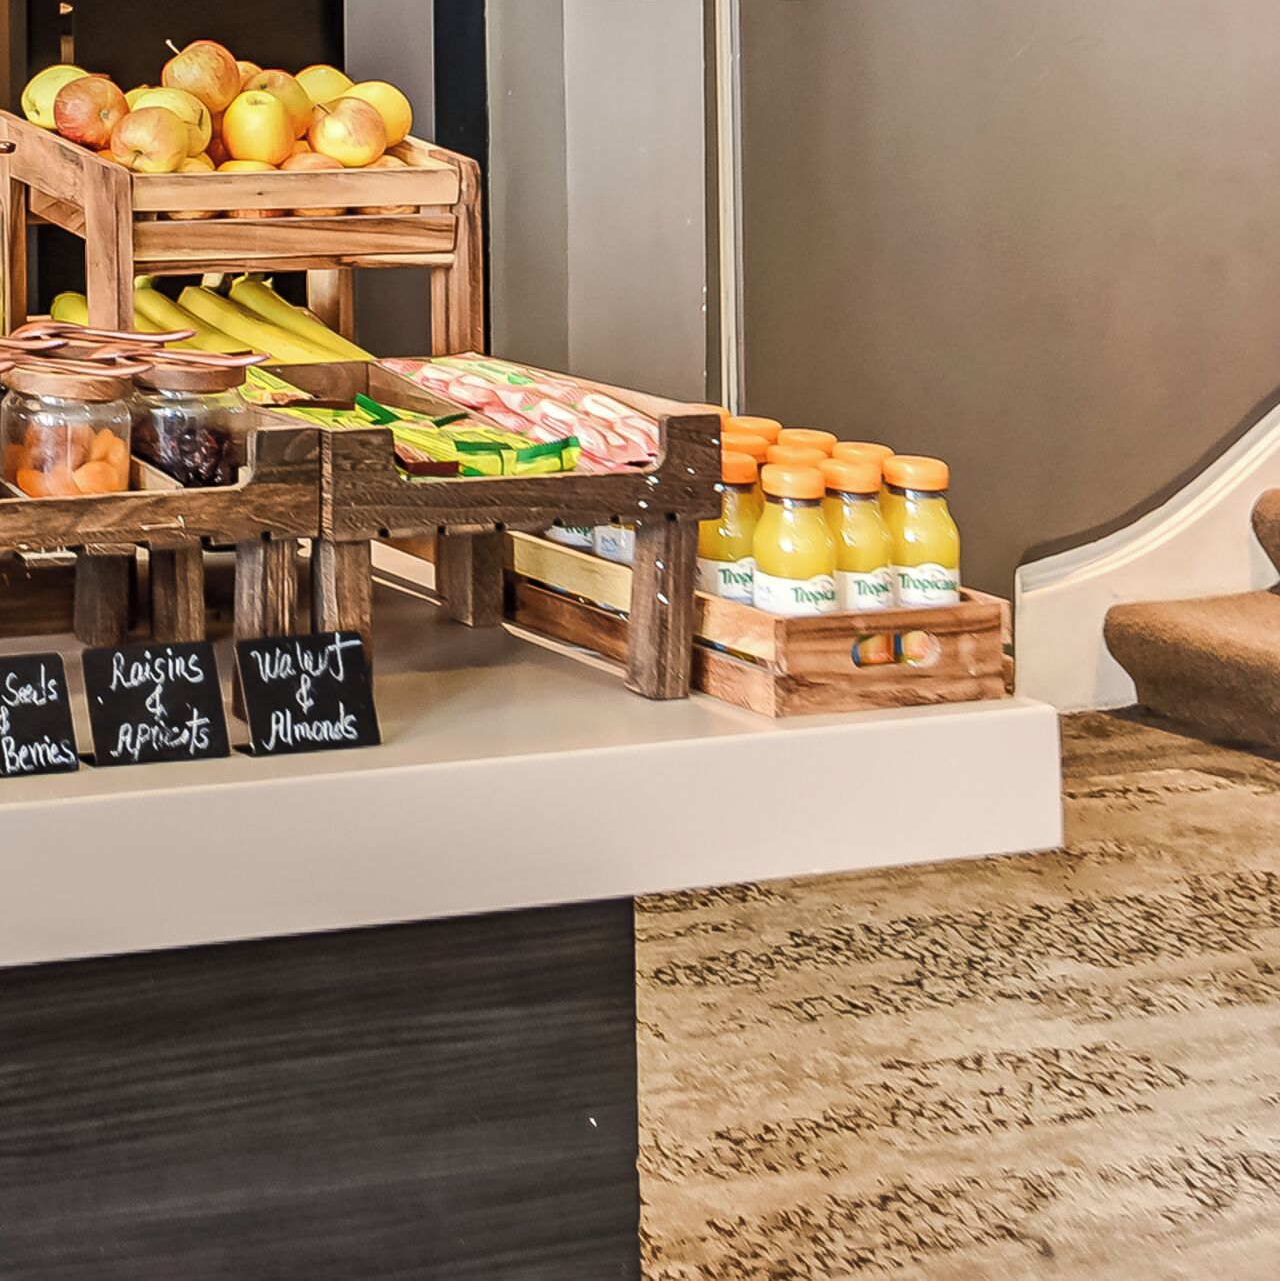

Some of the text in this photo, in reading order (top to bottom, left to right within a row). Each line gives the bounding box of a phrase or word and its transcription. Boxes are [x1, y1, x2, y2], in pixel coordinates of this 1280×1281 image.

[145, 684, 168, 719] &
[295, 673, 315, 715] &
[261, 700, 359, 751] Almonds
[1, 735, 76, 774] Berries
